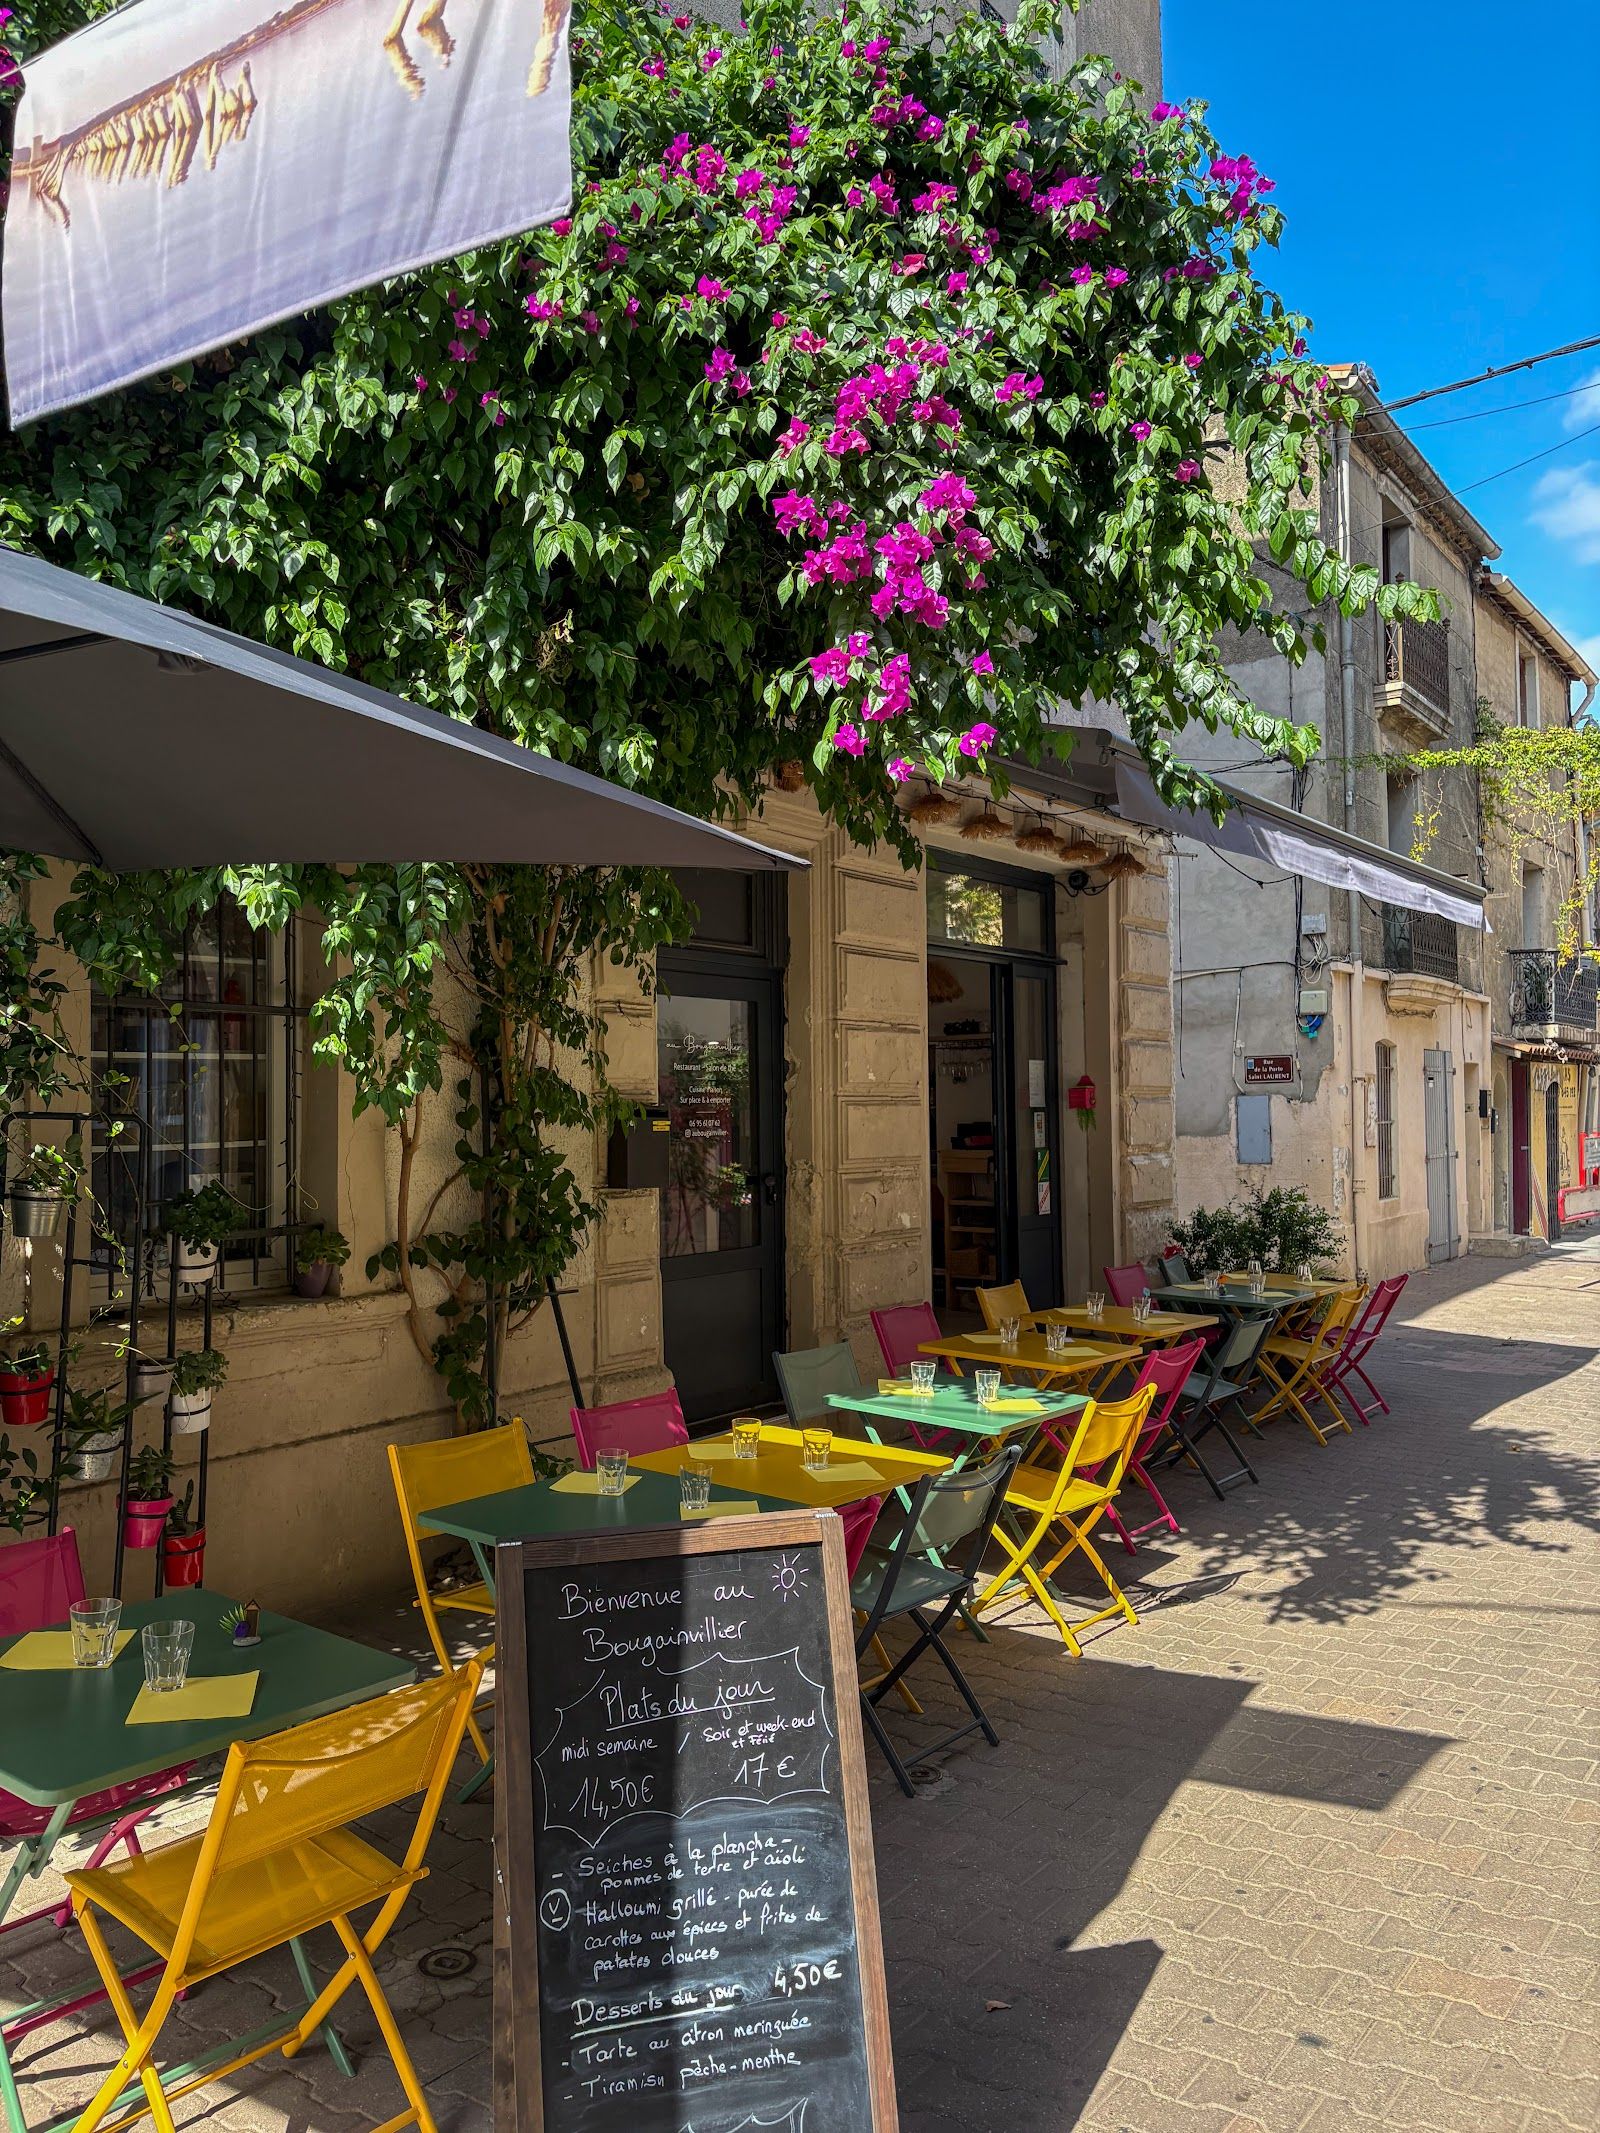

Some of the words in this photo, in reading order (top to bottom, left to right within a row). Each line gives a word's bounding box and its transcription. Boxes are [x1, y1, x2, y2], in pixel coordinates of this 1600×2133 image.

[673, 1062, 701, 1071] Restaurant
[705, 1062, 719, 1072] Salon
[720, 1063, 727, 1071] de
[679, 1096, 688, 1104] Sur
[688, 1096, 701, 1105] place
[710, 1096, 732, 1105] emporter
[558, 1583, 682, 1620] Bienvenue
[714, 1585, 755, 1601] au
[582, 1616, 747, 1667] Bougainvillier
[600, 1680, 661, 1725] Plats
[667, 1683, 698, 1713] du
[714, 1679, 775, 1720] jour
[562, 1736, 590, 1762] midi
[597, 1735, 658, 1757] semaine
[702, 1726, 731, 1743] Soir
[738, 1720, 753, 1736] et
[756, 1709, 816, 1734] week-end
[731, 1739, 745, 1749] et
[568, 1774, 655, 1821] 14,50€
[578, 1854, 653, 1877] Seiches
[664, 1842, 679, 1867] à
[687, 1837, 706, 1860] la
[711, 1831, 778, 1866] plancha
[600, 1872, 662, 1896] pommes
[667, 1865, 685, 1881] de
[694, 1860, 733, 1876] terre
[742, 1851, 760, 1870] et
[763, 1844, 806, 1866] aïoli
[583, 1897, 662, 1927] Halloumi
[665, 1886, 717, 1920] grillé
[738, 1879, 776, 1909] purée
[779, 1878, 799, 1898] de
[584, 1927, 643, 1951] carottes
[650, 1929, 676, 1941] aux
[682, 1919, 729, 1947] épices
[734, 1908, 753, 1930] et
[759, 1901, 798, 1936] frites
[804, 1904, 829, 1922] de
[593, 1950, 651, 1983] patates
[661, 1945, 720, 1966] douces
[570, 1990, 664, 2027] Desserts
[671, 1987, 699, 2006] du
[705, 1983, 741, 2009] jour
[774, 1959, 843, 1998] 4,50€
[578, 2037, 638, 2065] Tarte
[648, 2039, 671, 2050] au
[681, 2021, 724, 2047] citron
[734, 2008, 812, 2040] meringuée
[580, 2072, 666, 2098] Tiramisu
